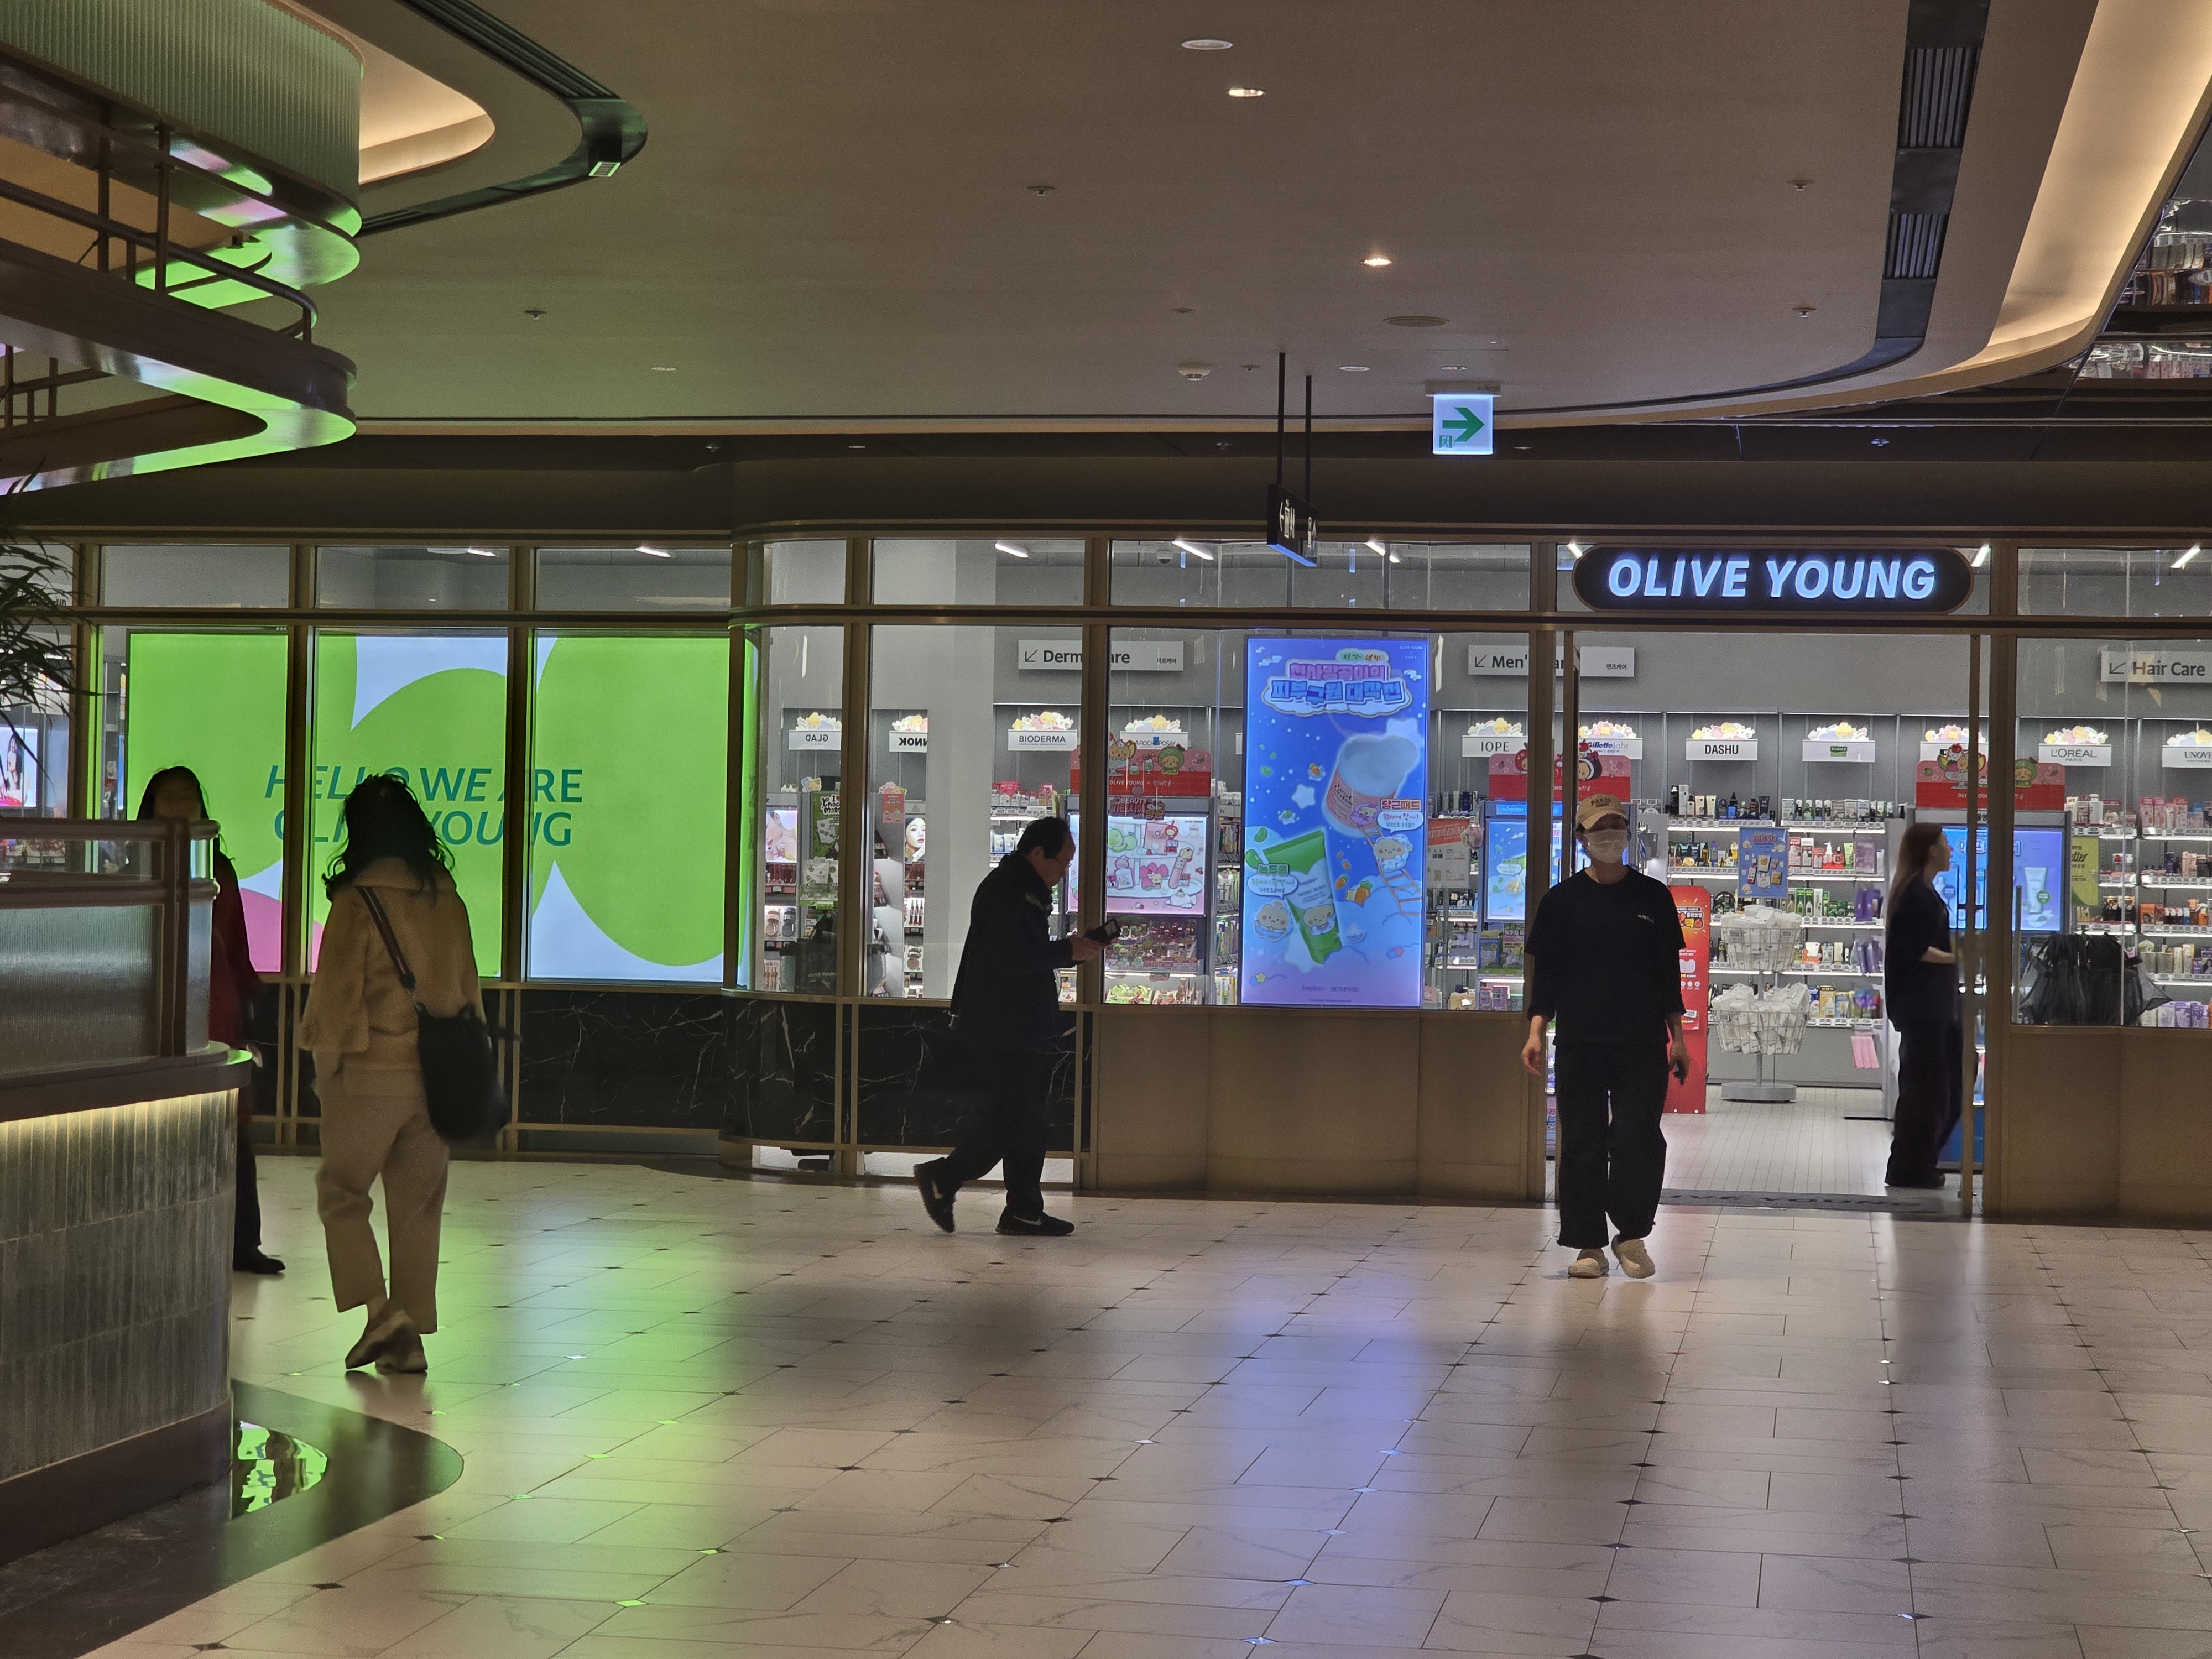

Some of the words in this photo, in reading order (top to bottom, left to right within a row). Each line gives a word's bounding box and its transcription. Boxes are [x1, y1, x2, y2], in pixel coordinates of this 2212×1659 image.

[1608, 558, 1750, 597] OLIVE
[1766, 559, 1936, 599] YOUNG
[1044, 649, 1082, 663] Derm
[1491, 655, 1528, 669] Men'
[2132, 660, 2167, 677] Hair
[2171, 661, 2206, 677] Care
[1271, 680, 1344, 705] 피부구원
[1345, 680, 1402, 702] 대작전
[1480, 741, 1510, 752] IOPE
[1704, 744, 1739, 755] DASHU
[2051, 748, 2098, 758] L'ORÉAL
[419, 767, 492, 802] WE
[498, 769, 583, 803] RE
